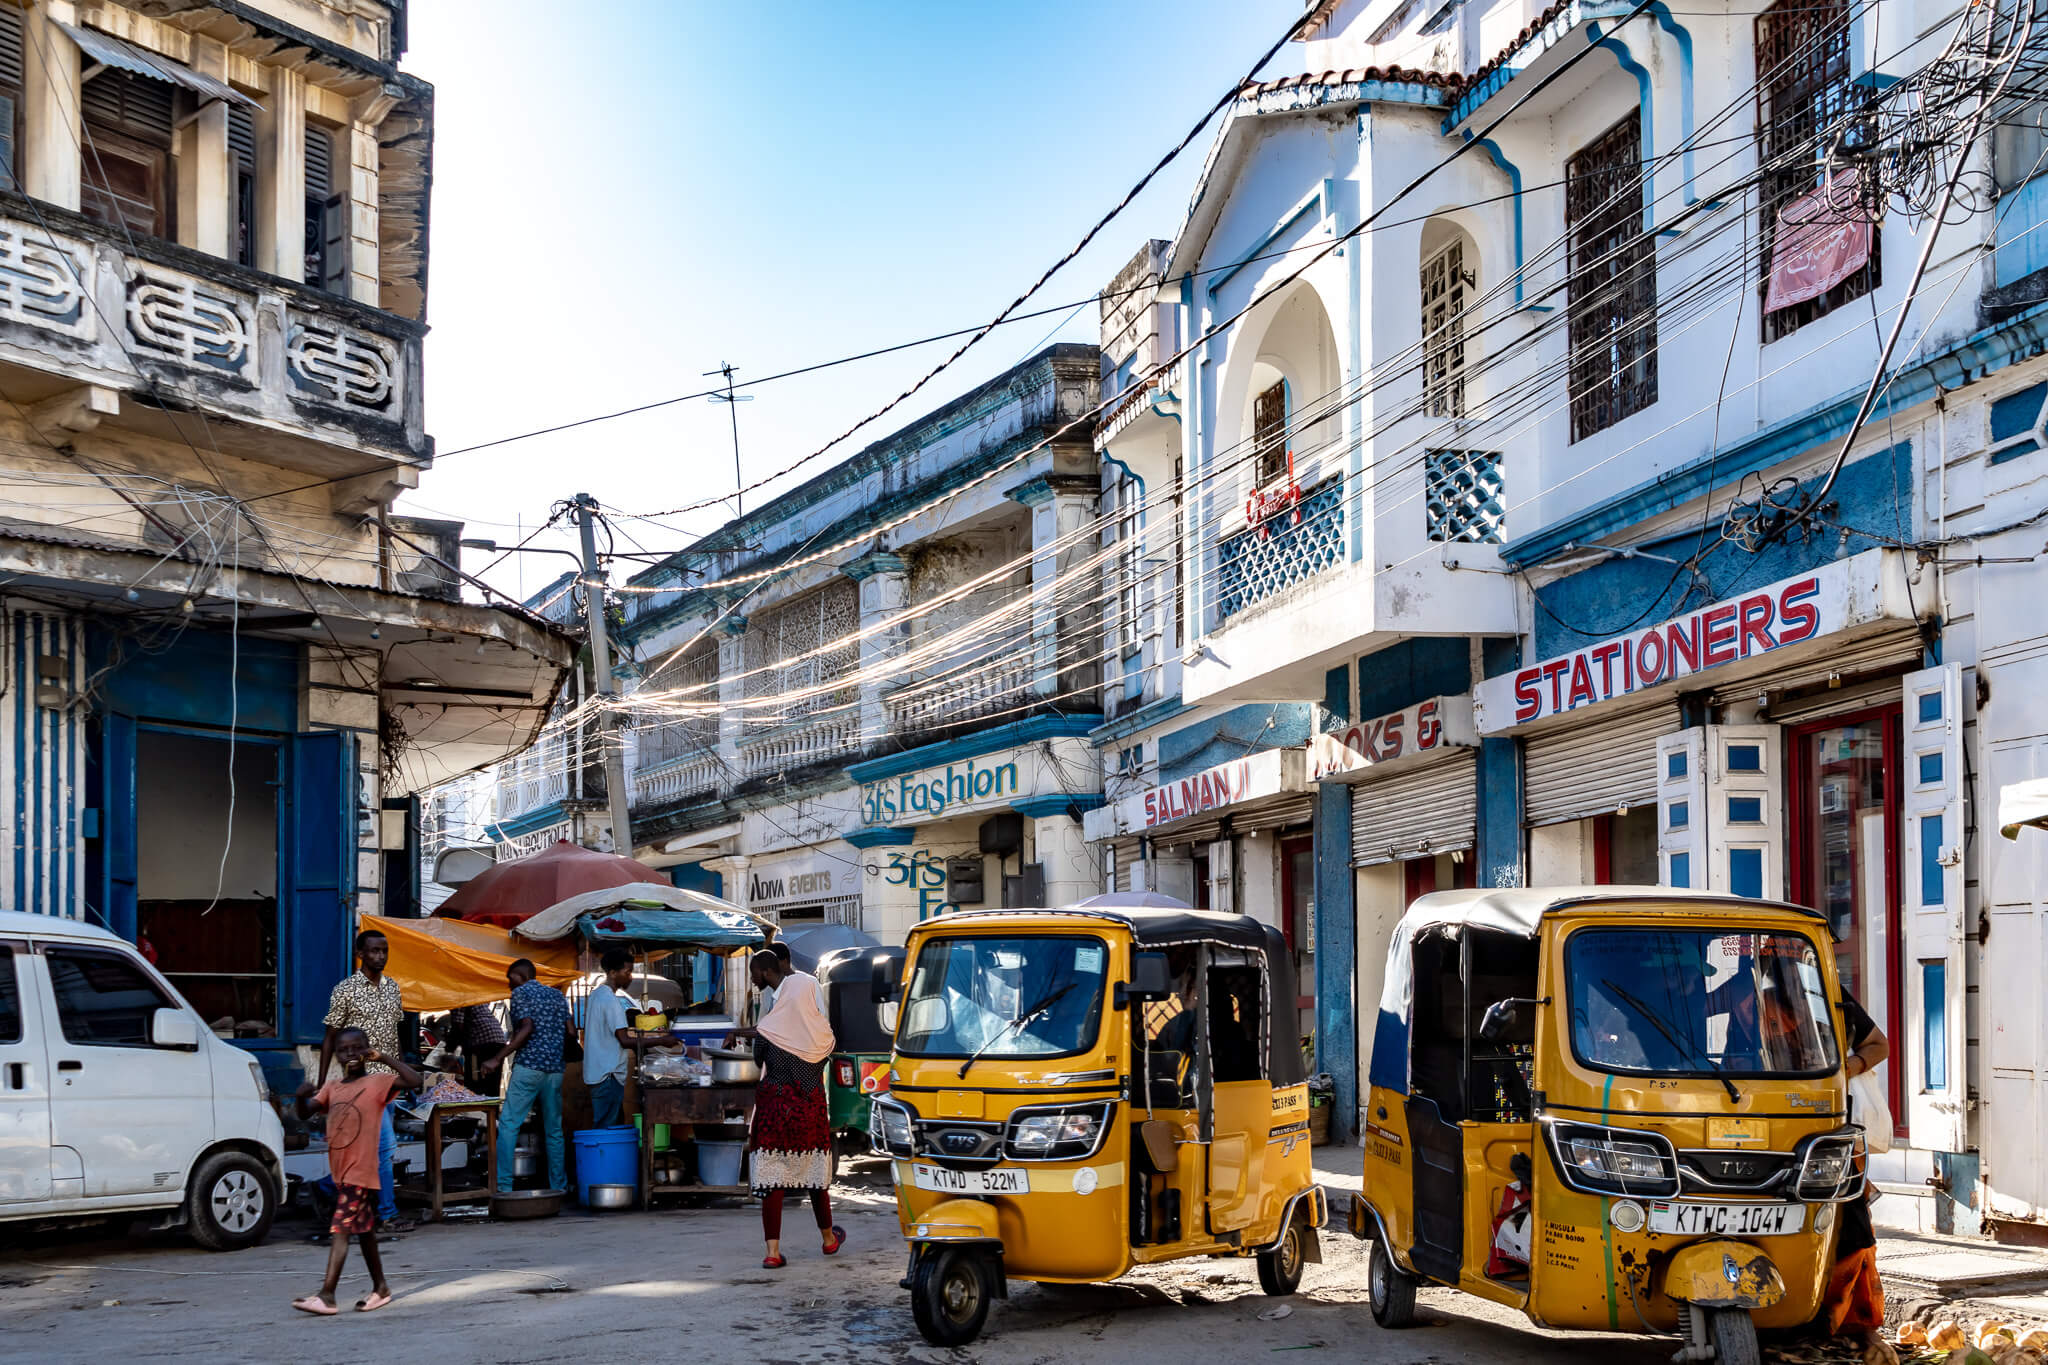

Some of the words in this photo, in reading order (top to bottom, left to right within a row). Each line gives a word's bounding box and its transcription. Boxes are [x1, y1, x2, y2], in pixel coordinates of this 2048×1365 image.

[1514, 577, 1820, 726] STATIONERS
[1416, 700, 1444, 751] &
[900, 760, 1018, 817] Fashion
[1144, 761, 1250, 827] SALMANJI
[750, 873, 784, 902] ADIVA
[789, 871, 832, 896] EVENTS
[946, 1134, 977, 1147] TVS
[932, 1167, 967, 1190] KTWD
[982, 1169, 1018, 1191] 522M
[1719, 1161, 1755, 1176] TVS
[1675, 1205, 1728, 1233] KTWC
[1738, 1206, 1787, 1233] 104W
